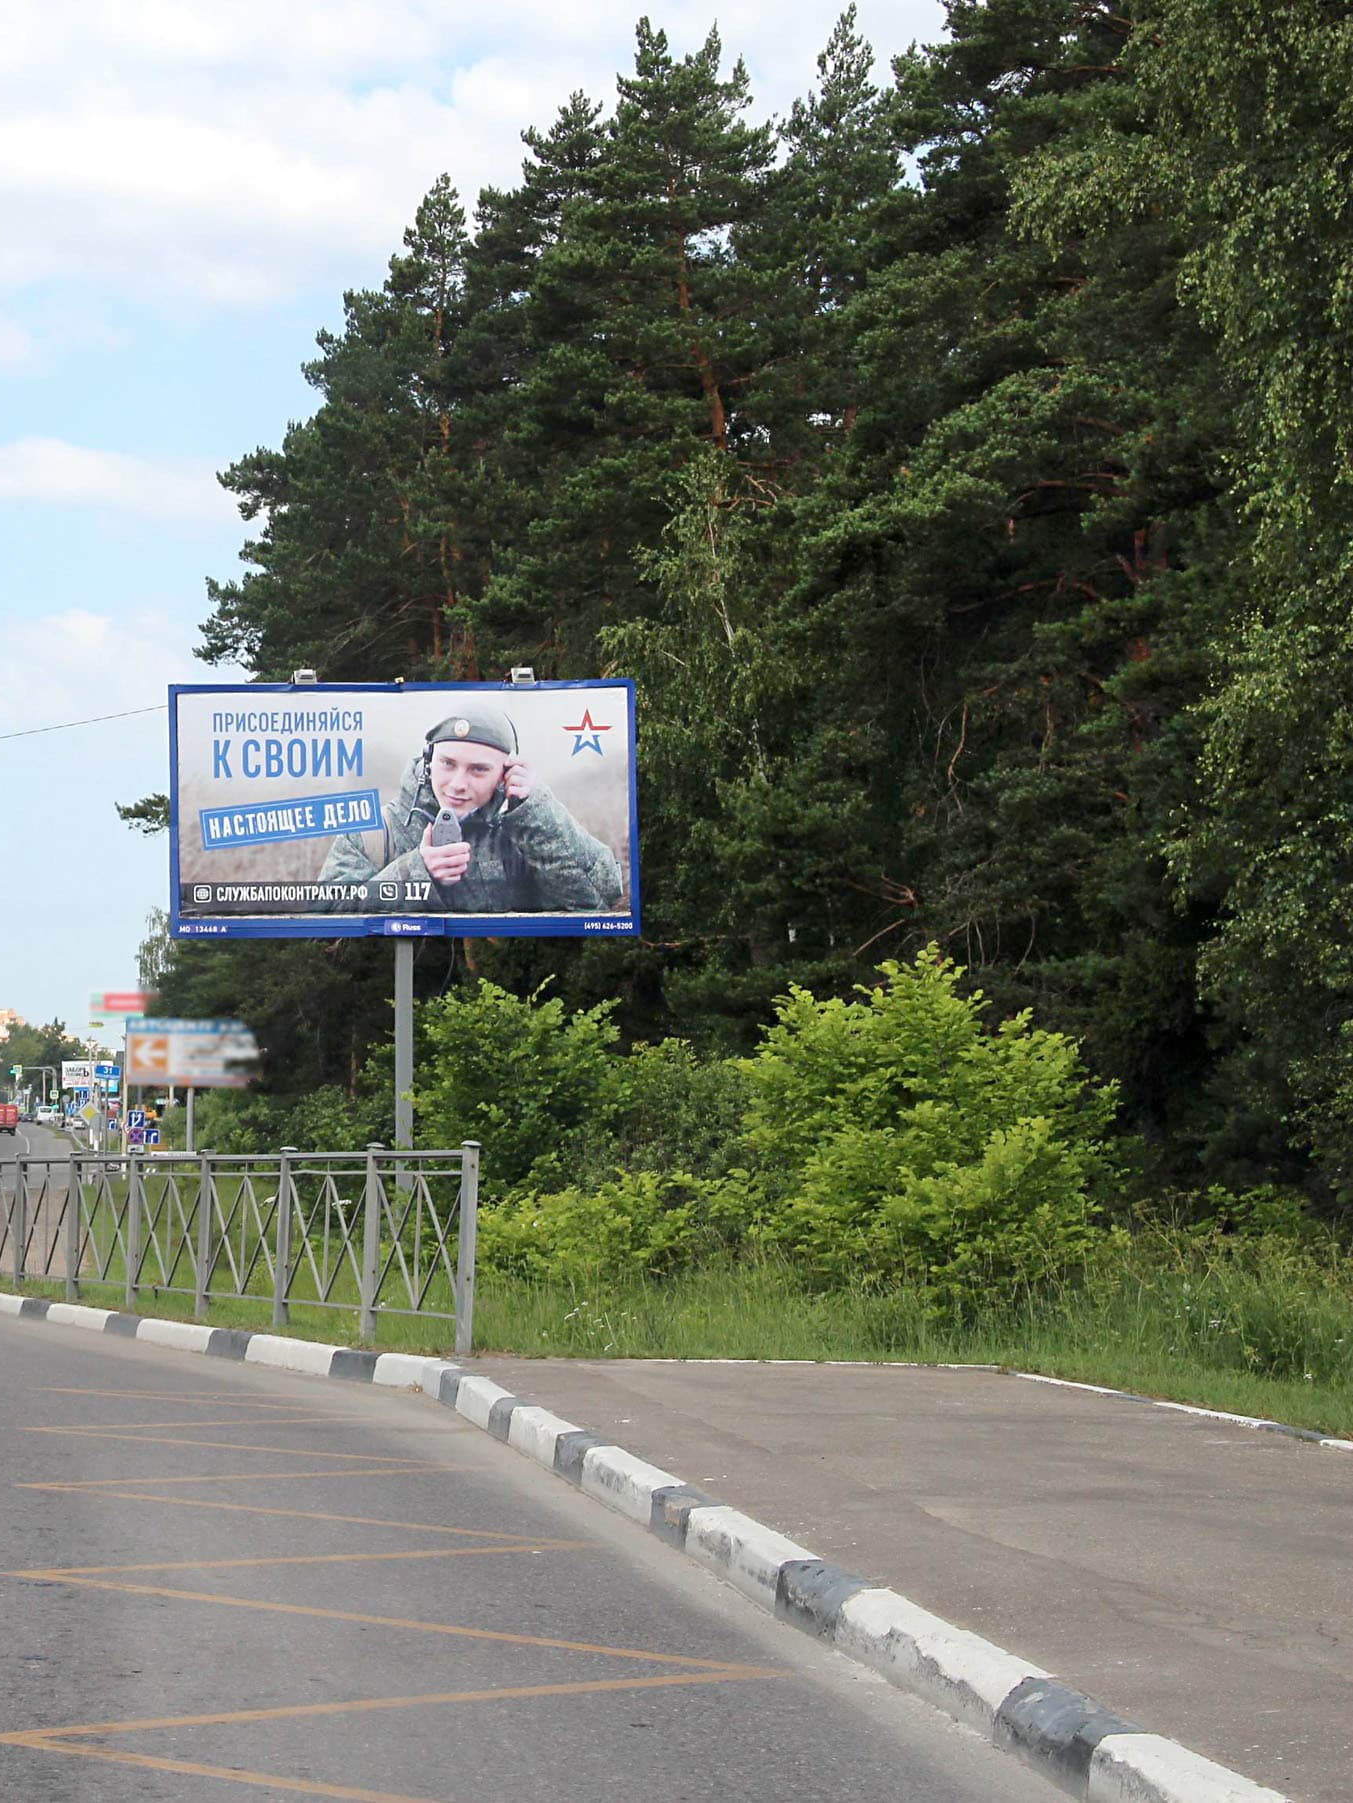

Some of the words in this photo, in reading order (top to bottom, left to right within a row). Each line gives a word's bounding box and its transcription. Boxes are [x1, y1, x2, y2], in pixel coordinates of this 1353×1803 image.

[212, 707, 363, 734] ПРИСОЕДИНЯЙСЯ
[213, 739, 233, 778] К
[242, 738, 363, 778] СВОИМ
[208, 806, 316, 840] НАСТОЯЩЕЕ
[323, 799, 371, 829] ДЕЛО
[216, 884, 368, 902] СЛУЖБАПОКОНТРАКТУ.РФ
[405, 882, 432, 901] 117
[402, 923, 422, 931] Russ
[584, 922, 601, 930] (495)
[103, 1066, 113, 1074] 31
